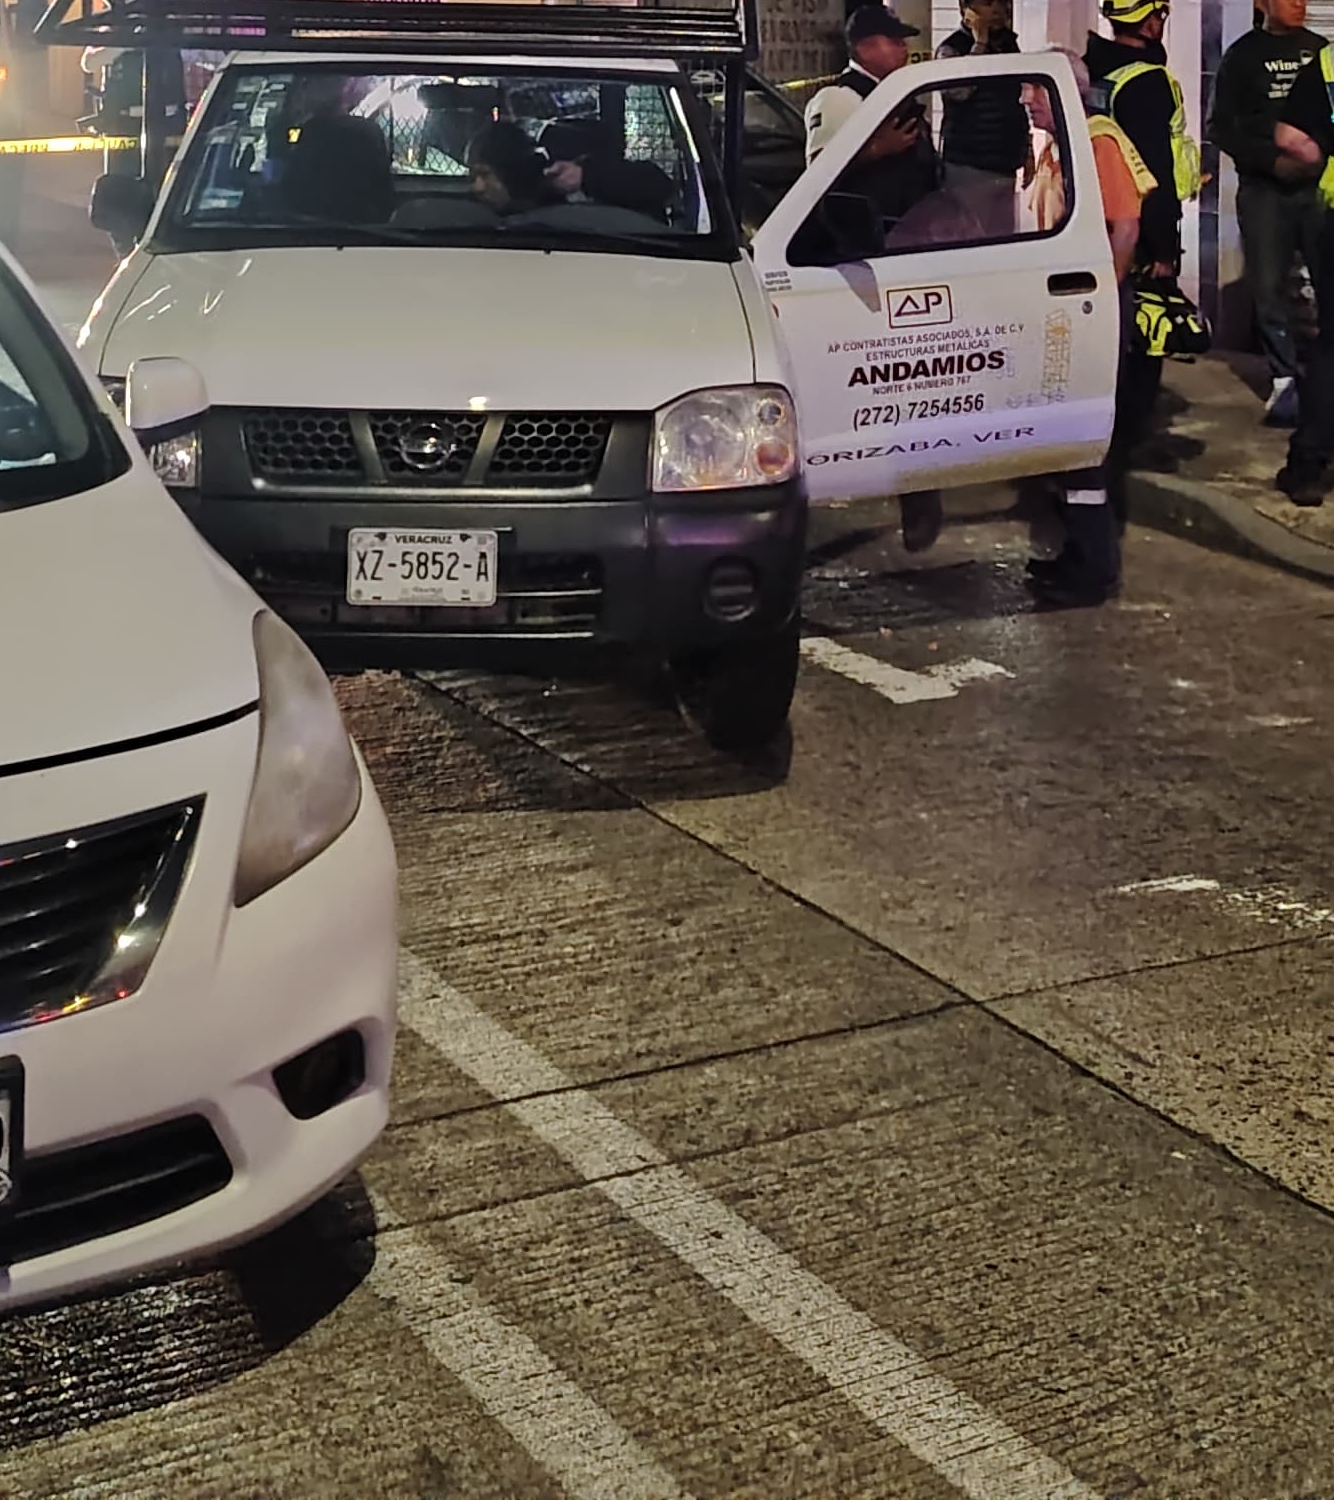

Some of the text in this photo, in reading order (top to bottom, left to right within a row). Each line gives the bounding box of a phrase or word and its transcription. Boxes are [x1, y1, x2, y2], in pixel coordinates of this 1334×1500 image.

[893, 291, 943, 318] AP
[827, 344, 841, 354] AP
[842, 336, 914, 352] CONTRATISTAS
[916, 329, 974, 344] ASOCIADOS,
[994, 325, 1007, 335] DE
[866, 347, 936, 362] ESTRUCTURAS
[848, 350, 1006, 387] ANDAMIOS
[873, 384, 905, 396] NORTE
[914, 377, 954, 391] NUMERO
[853, 393, 985, 432] (272) 7254556
[973, 427, 1035, 443] VER
[394, 534, 454, 545] VERACRUZ
[354, 549, 490, 583] XZ-5852-A
